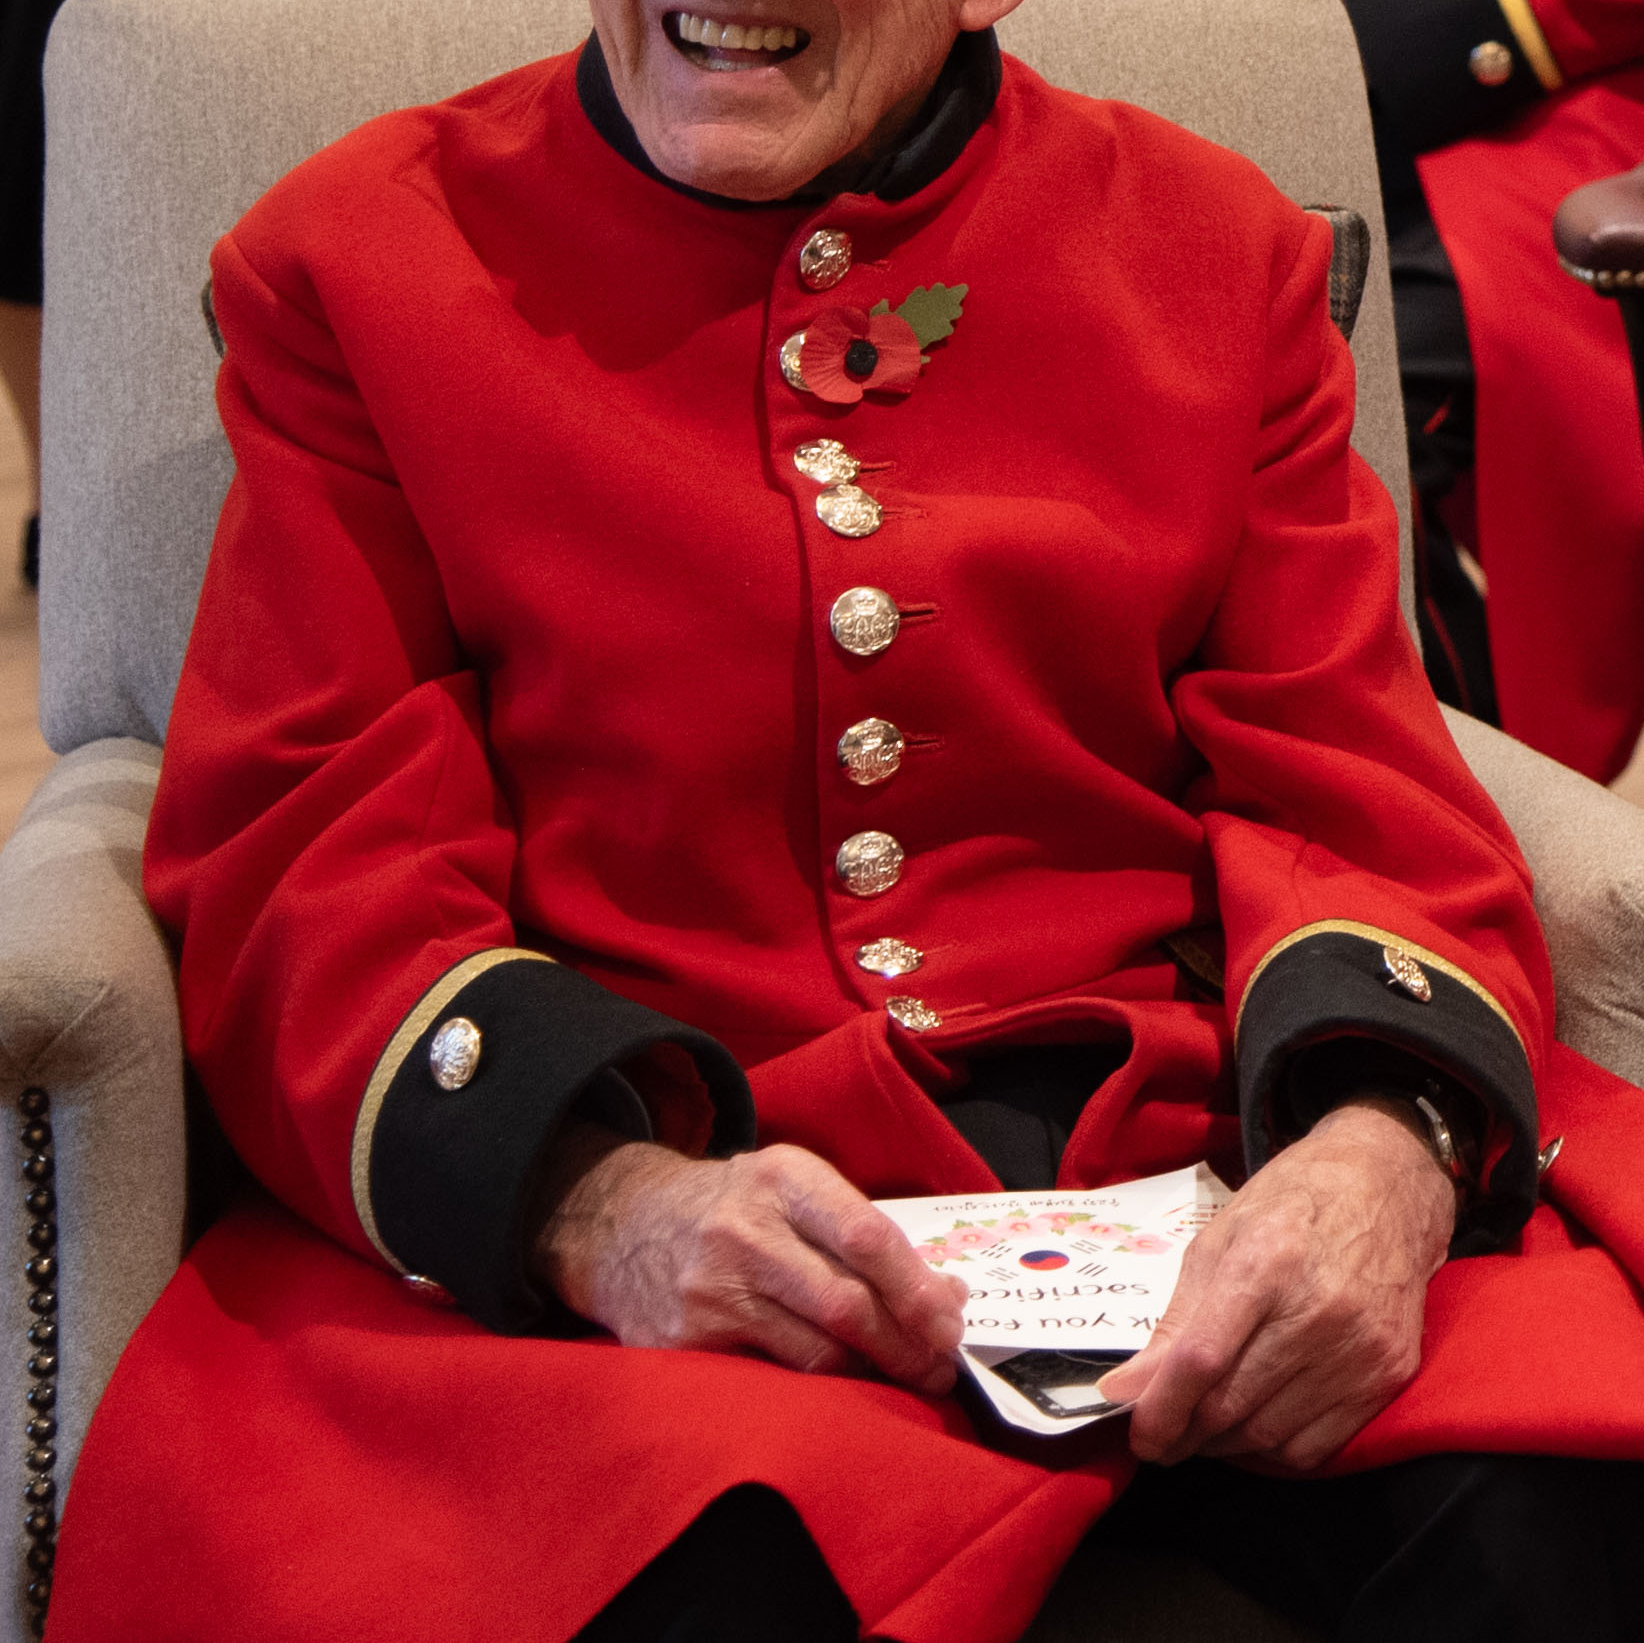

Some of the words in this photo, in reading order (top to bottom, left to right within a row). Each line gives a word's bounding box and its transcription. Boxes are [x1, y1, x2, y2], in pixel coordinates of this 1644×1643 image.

[968, 1283, 1150, 1303] sacrifice
[963, 1319, 1023, 1331] for
[1040, 1312, 1115, 1329] you
